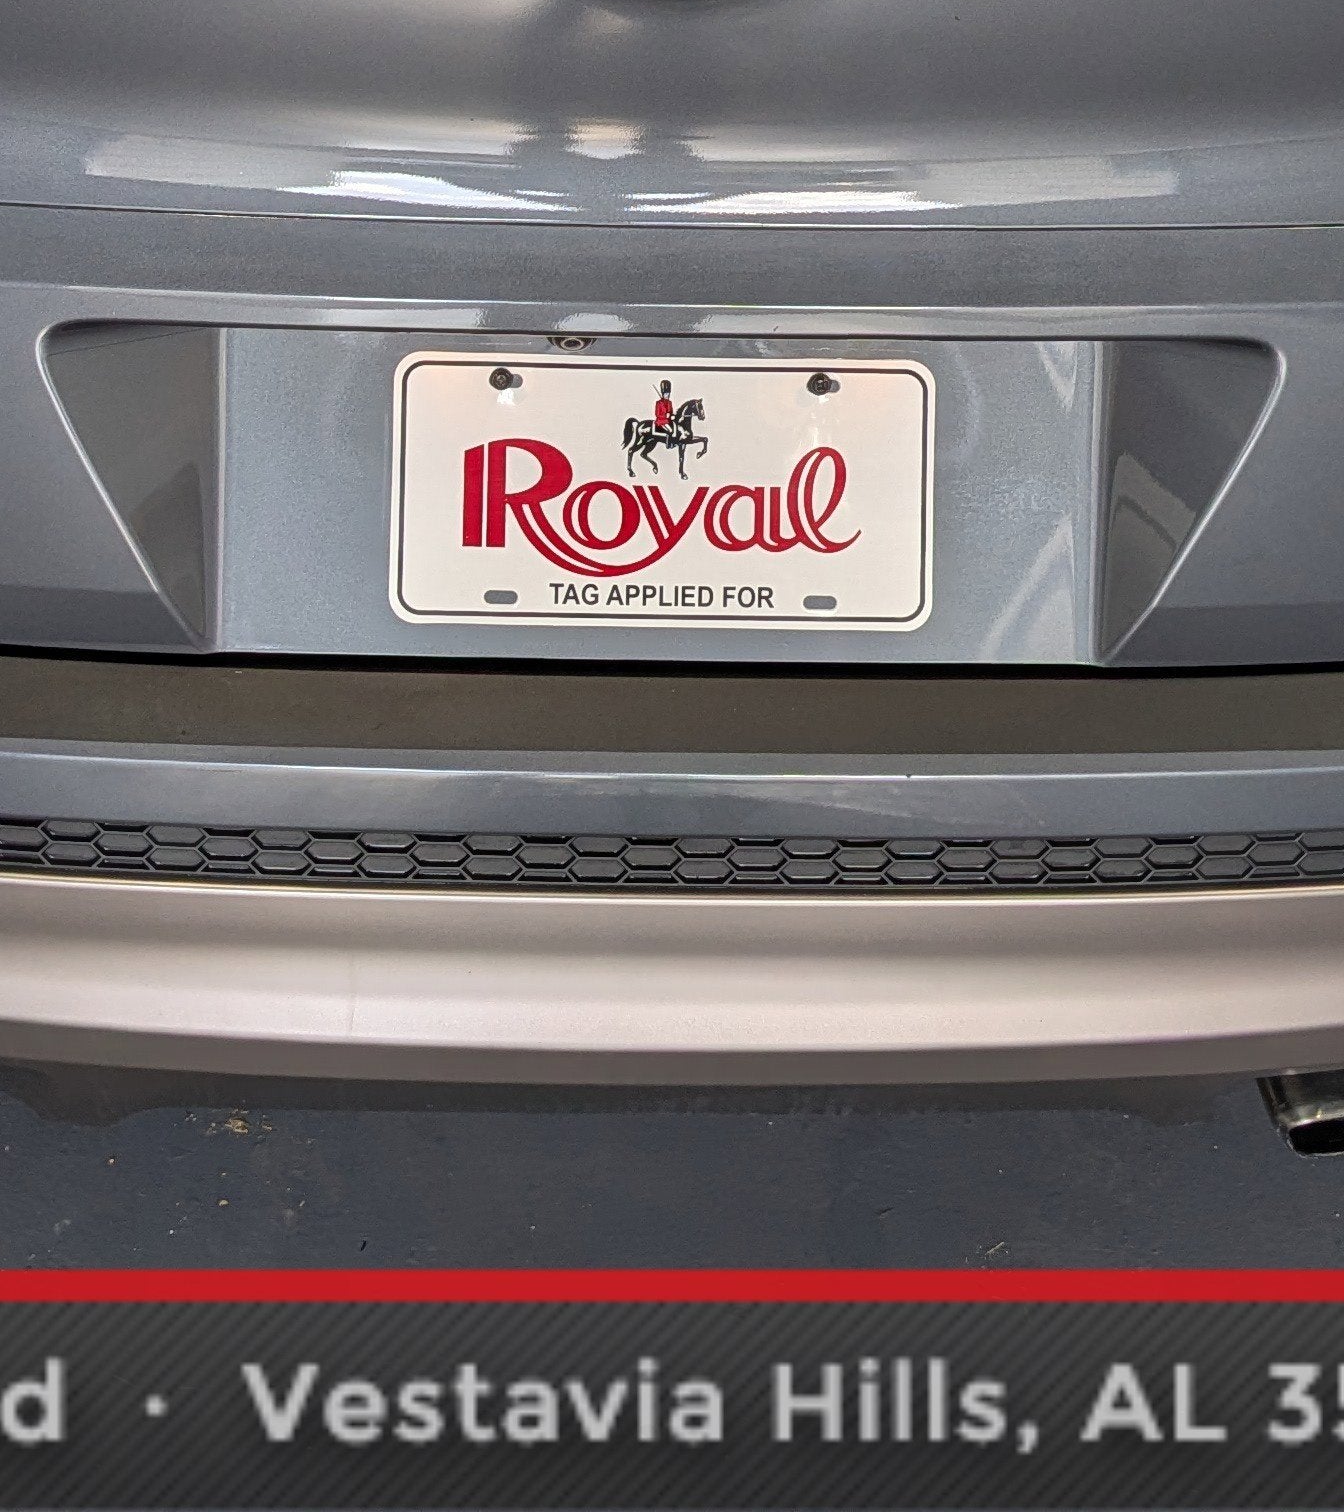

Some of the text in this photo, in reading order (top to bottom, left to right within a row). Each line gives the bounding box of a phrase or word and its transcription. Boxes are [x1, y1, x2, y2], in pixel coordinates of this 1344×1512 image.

[462, 437, 862, 578] Royal
[548, 582, 775, 609] TAG APPLIED FOR
